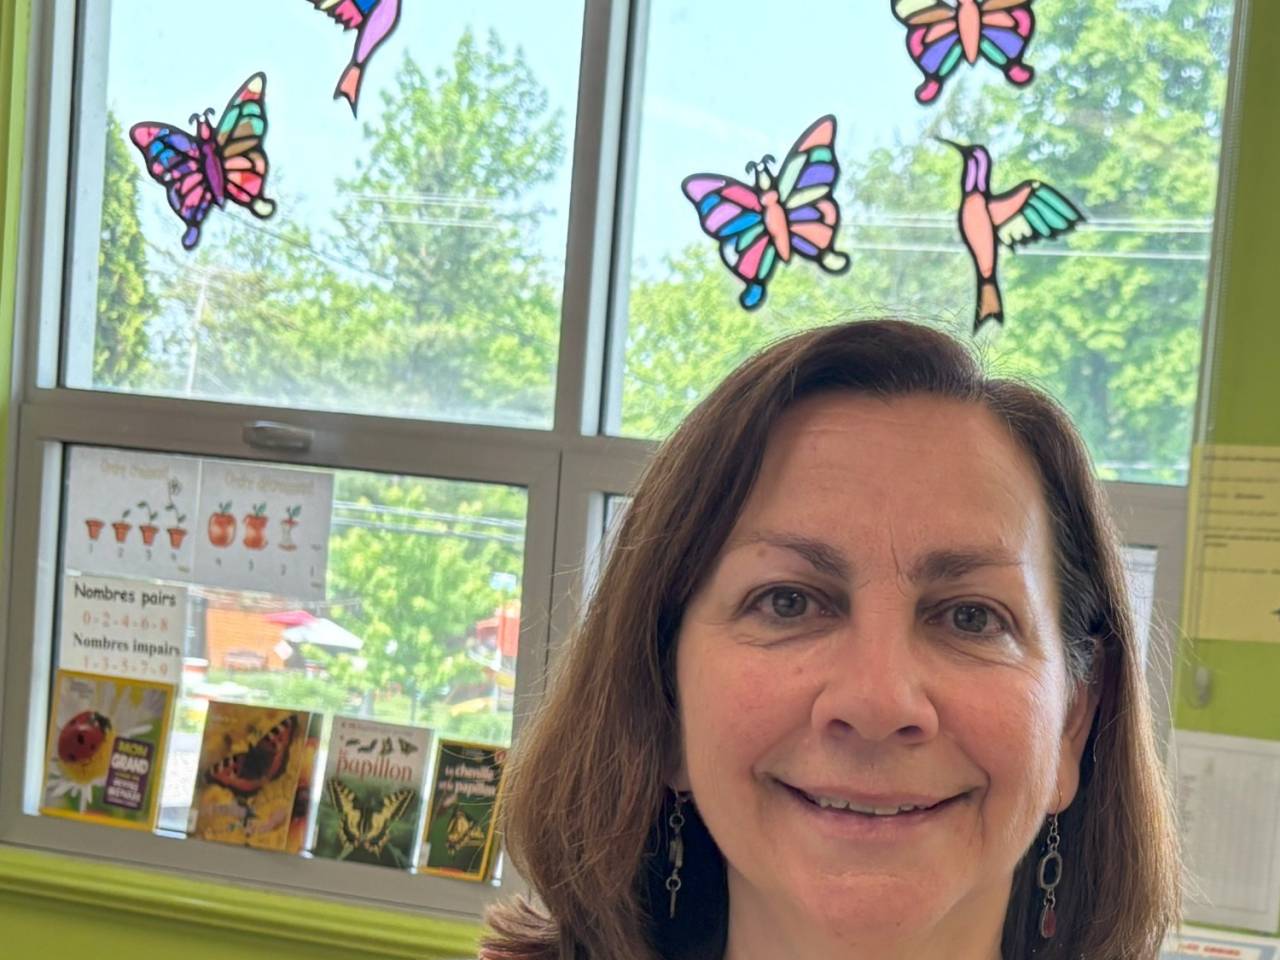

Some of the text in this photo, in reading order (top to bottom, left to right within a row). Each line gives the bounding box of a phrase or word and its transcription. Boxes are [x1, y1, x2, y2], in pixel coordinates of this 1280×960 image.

[74, 582, 177, 608] Nombres pairs
[73, 632, 181, 659] Nombres impairs
[111, 754, 149, 776] GRAND
[336, 756, 413, 782] papillon
